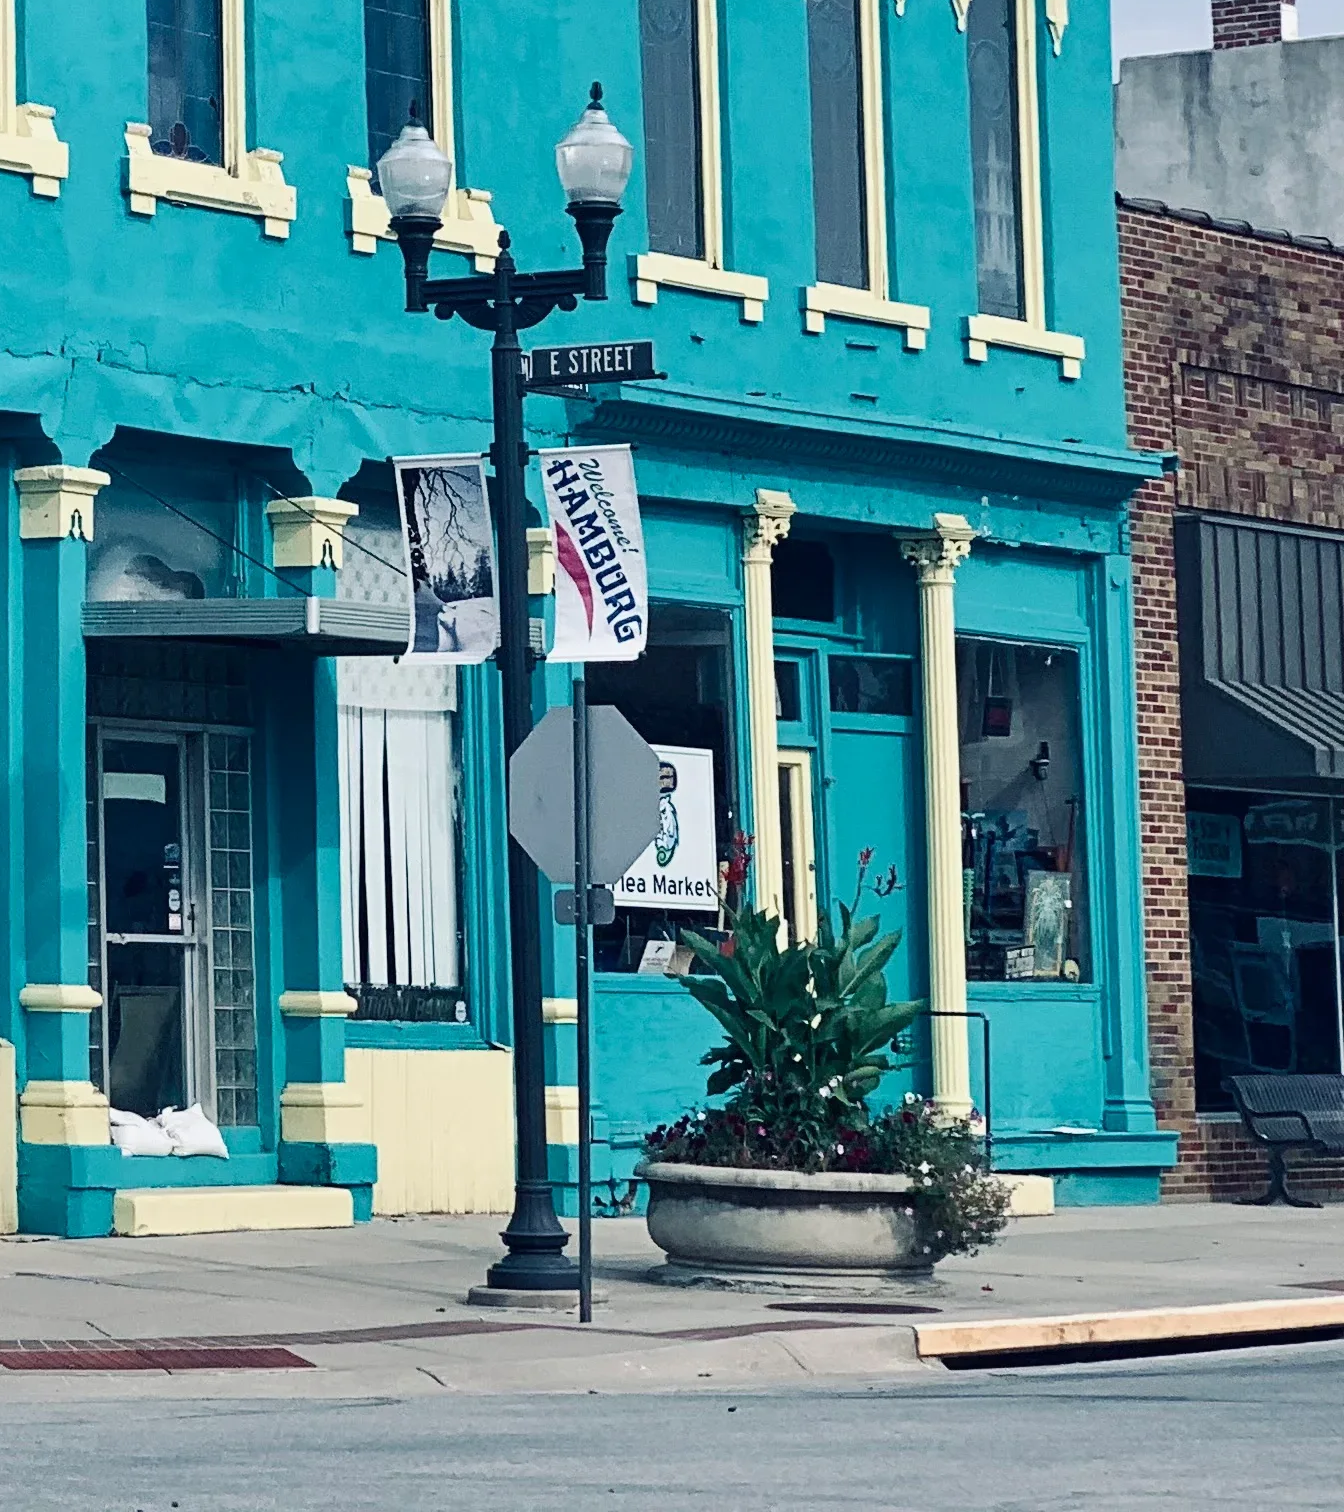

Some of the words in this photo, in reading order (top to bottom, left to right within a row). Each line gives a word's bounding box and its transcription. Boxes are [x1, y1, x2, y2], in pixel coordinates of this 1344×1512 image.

[550, 351, 561, 376] E
[568, 345, 634, 374] STREET
[578, 458, 639, 554] Welcome!
[547, 459, 642, 644] HAMBURG
[612, 875, 646, 893] lea
[652, 874, 712, 898] Market
